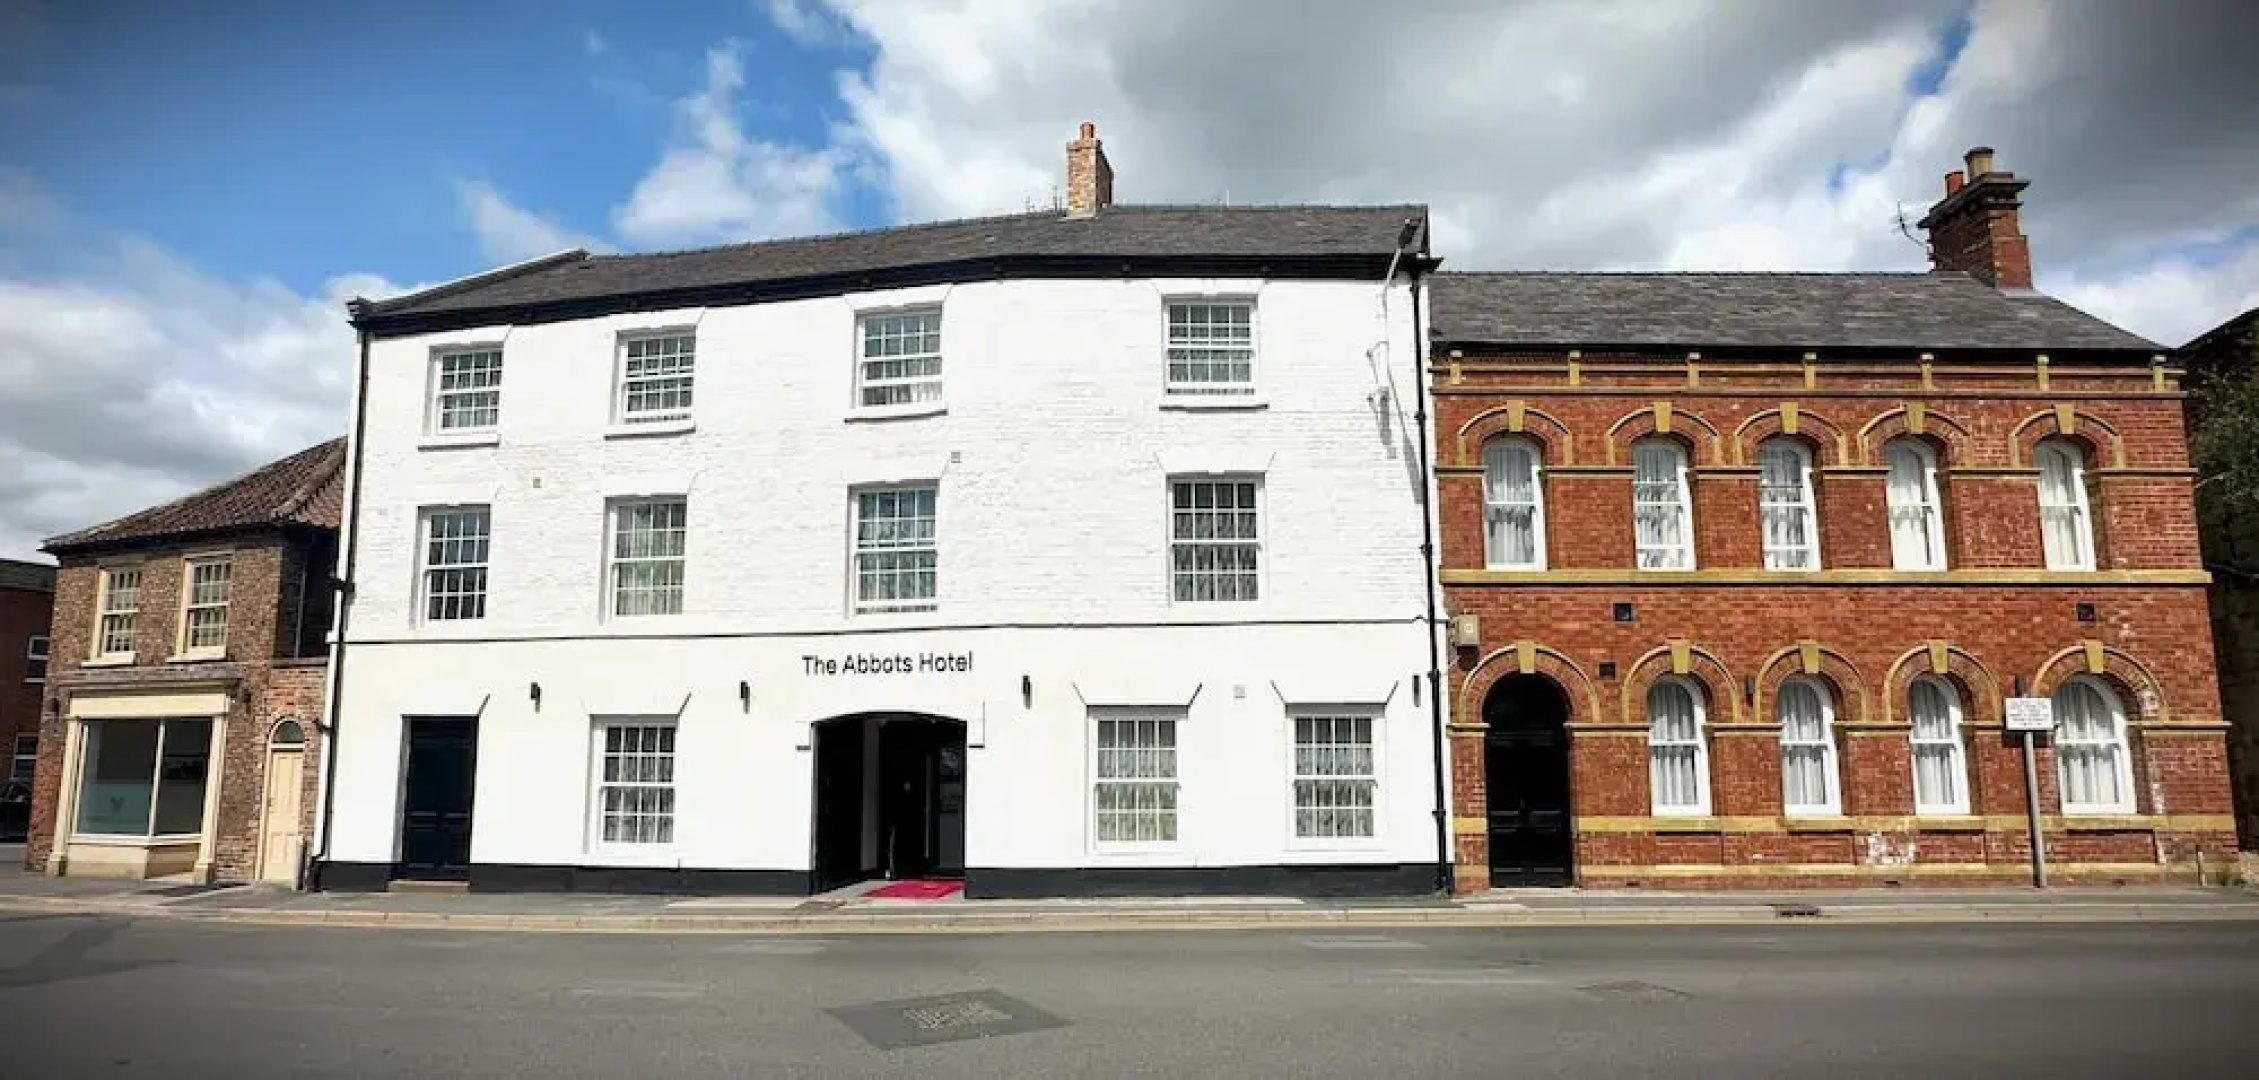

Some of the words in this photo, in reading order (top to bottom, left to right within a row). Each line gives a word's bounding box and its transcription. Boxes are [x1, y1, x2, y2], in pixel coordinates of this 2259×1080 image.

[802, 654, 837, 675] The
[842, 653, 913, 674] Abbots
[919, 651, 973, 672] Hotel
